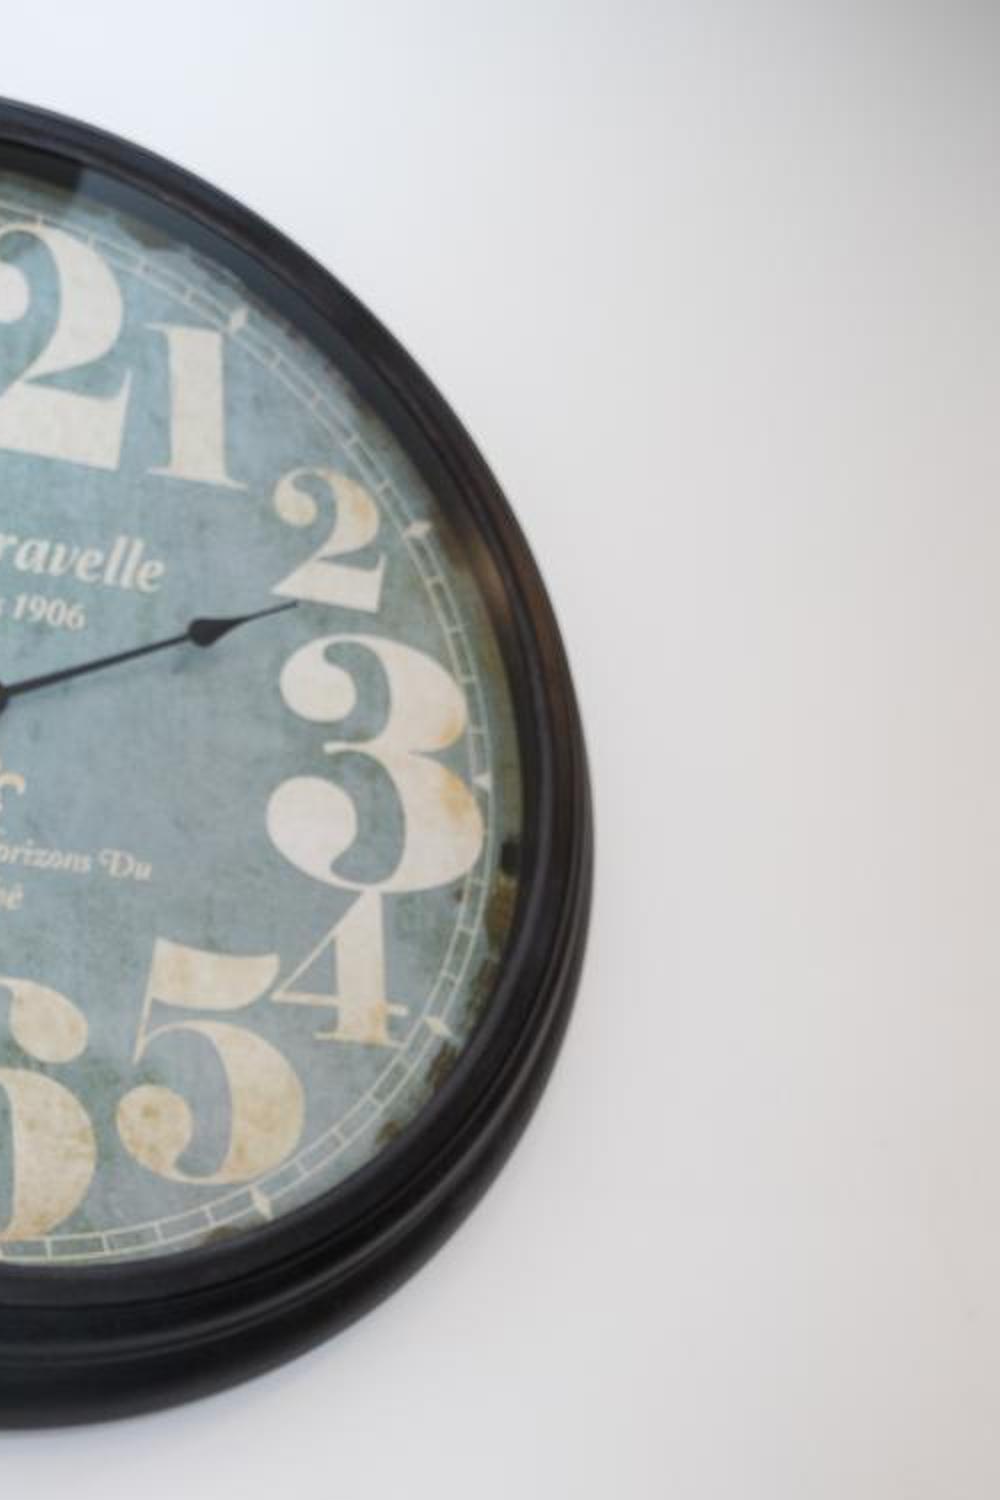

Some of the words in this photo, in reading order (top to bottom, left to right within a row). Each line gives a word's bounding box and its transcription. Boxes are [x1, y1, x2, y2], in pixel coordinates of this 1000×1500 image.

[144, 320, 249, 490] 1
[11, 591, 87, 632] 1906
[271, 466, 388, 613] 2
[264, 633, 485, 894] 3
[99, 847, 152, 881] Du
[271, 891, 410, 1047] 4
[115, 937, 305, 1185] 5
